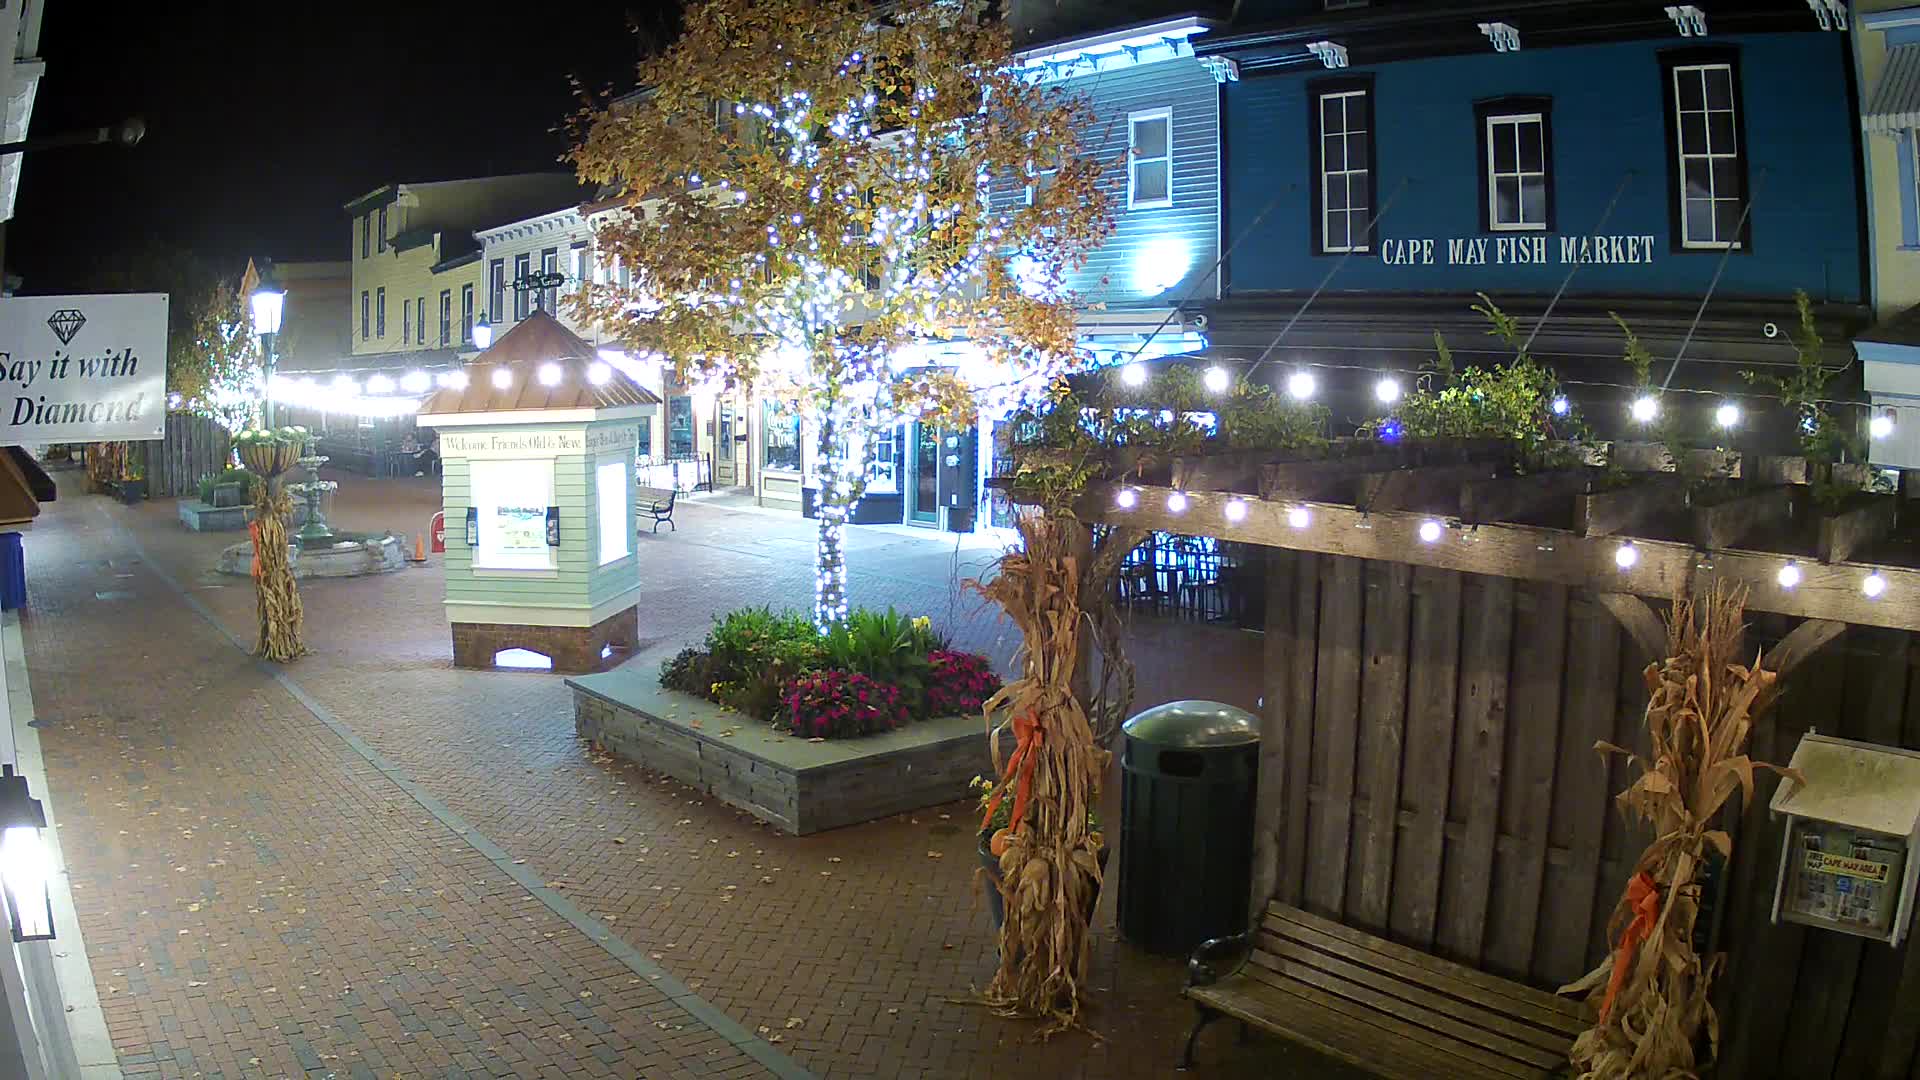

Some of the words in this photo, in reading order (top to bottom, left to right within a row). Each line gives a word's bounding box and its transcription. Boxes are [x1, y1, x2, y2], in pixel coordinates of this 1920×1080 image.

[1381, 238, 1434, 265] CAPE
[1448, 238, 1488, 265] MAY
[1496, 236, 1547, 264] FISH
[1560, 235, 1654, 264] MARKET
[0, 352, 41, 388] Say
[49, 350, 70, 380] it
[79, 347, 138, 377] with
[8, 391, 145, 426] Diamond
[444, 437, 488, 451] Welcome
[491, 436, 527, 450] Friends
[1824, 857, 1842, 868] CAPE
